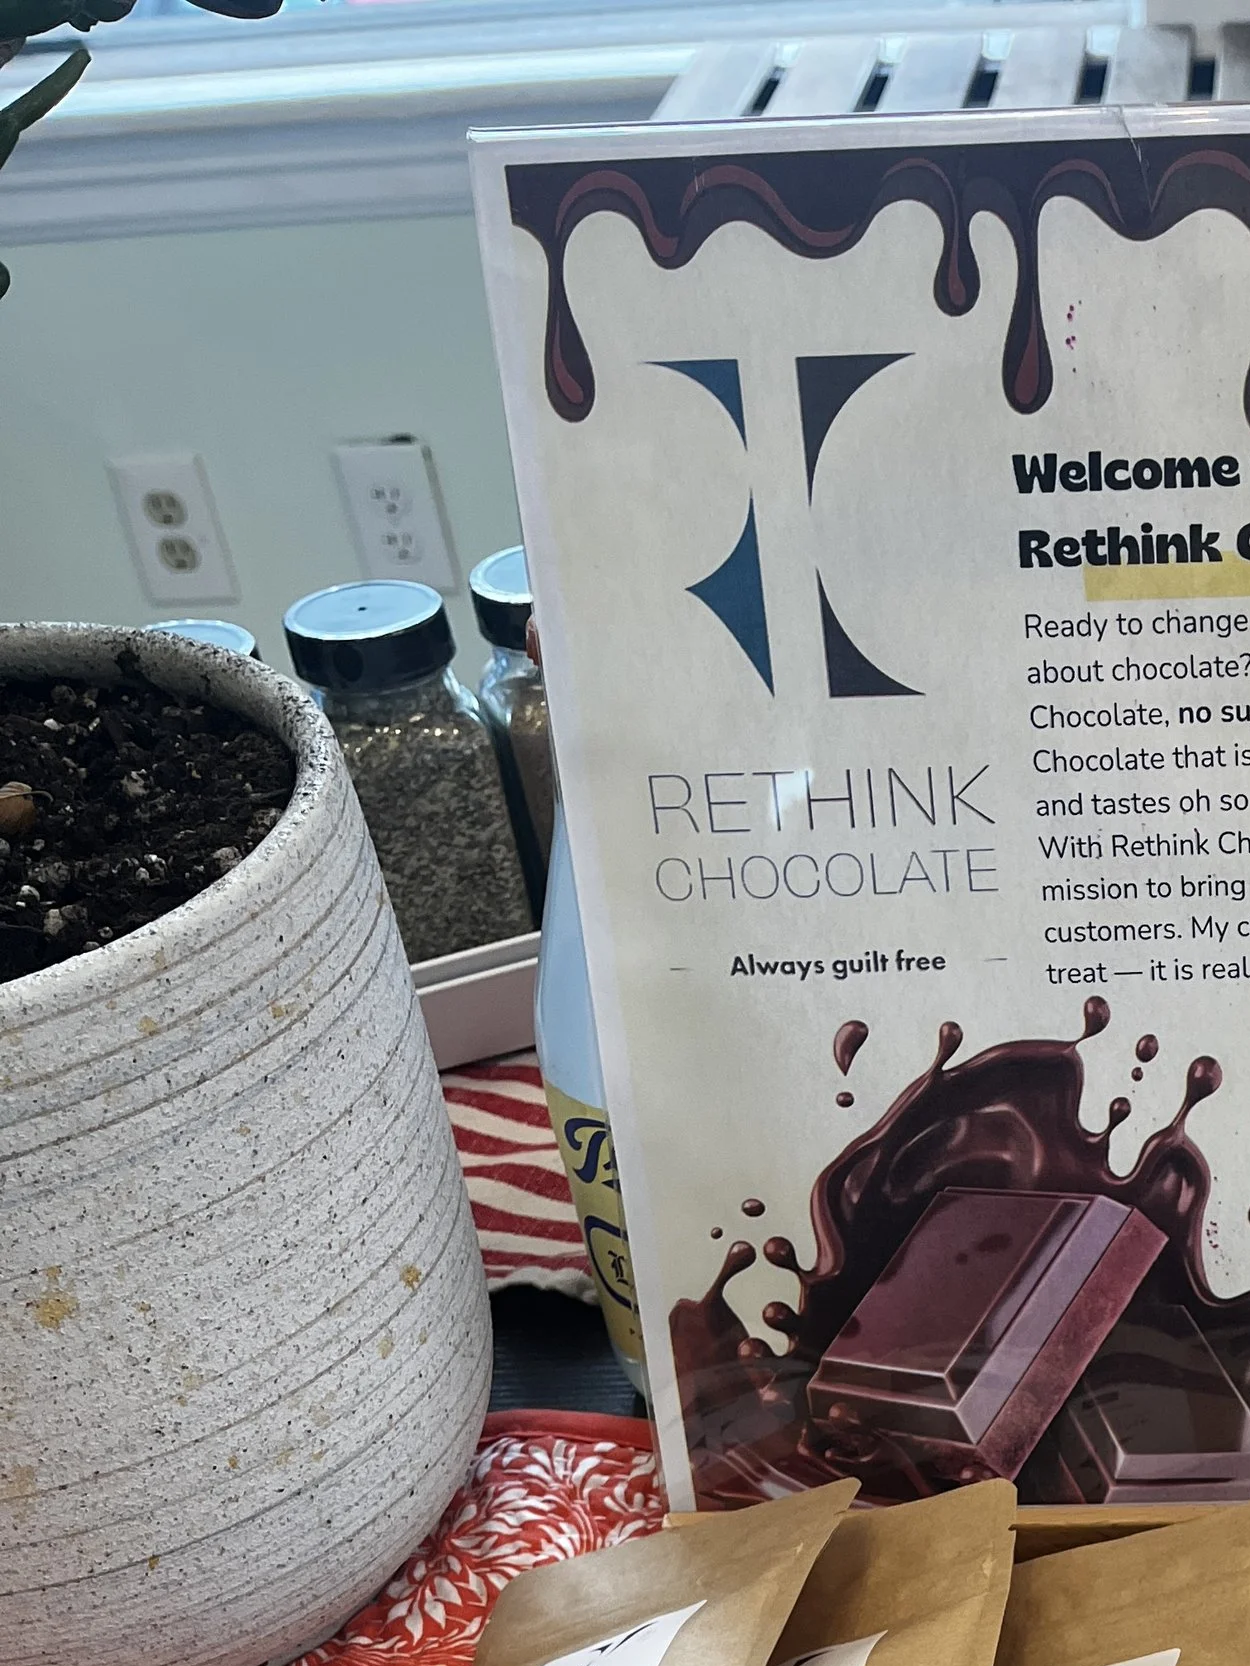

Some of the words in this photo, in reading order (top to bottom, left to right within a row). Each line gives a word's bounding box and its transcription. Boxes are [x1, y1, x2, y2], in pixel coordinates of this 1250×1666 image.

[1012, 451, 1240, 494] Welcome
[1018, 523, 1223, 568] Rethink
[1025, 612, 1108, 642] Ready
[1113, 613, 1143, 636] to
[1152, 609, 1248, 638] change
[1027, 659, 1104, 685] about
[1030, 699, 1169, 729] Chocolate,
[1179, 706, 1212, 724] no
[1033, 747, 1165, 773] Chocolate
[1171, 744, 1227, 769] that
[648, 764, 996, 835] RETHINK
[1036, 792, 1083, 816] and
[1091, 793, 1172, 815] tastes
[1179, 788, 1210, 813] oh
[1220, 794, 1249, 812] so
[1038, 828, 1104, 858] With
[1112, 831, 1210, 857] Rethink
[655, 848, 1000, 902] CHOCOLATE
[1042, 870, 1138, 901] mission
[1143, 872, 1174, 898] to
[1180, 873, 1245, 901] bring
[1044, 923, 1182, 943] customers.
[1187, 915, 1229, 943] My
[730, 954, 825, 981] Always
[832, 950, 889, 980] guilt
[895, 949, 946, 972] free
[1045, 963, 1108, 984] treat
[1150, 959, 1167, 981] it
[1173, 958, 1193, 980] is
[1202, 956, 1250, 980] real
